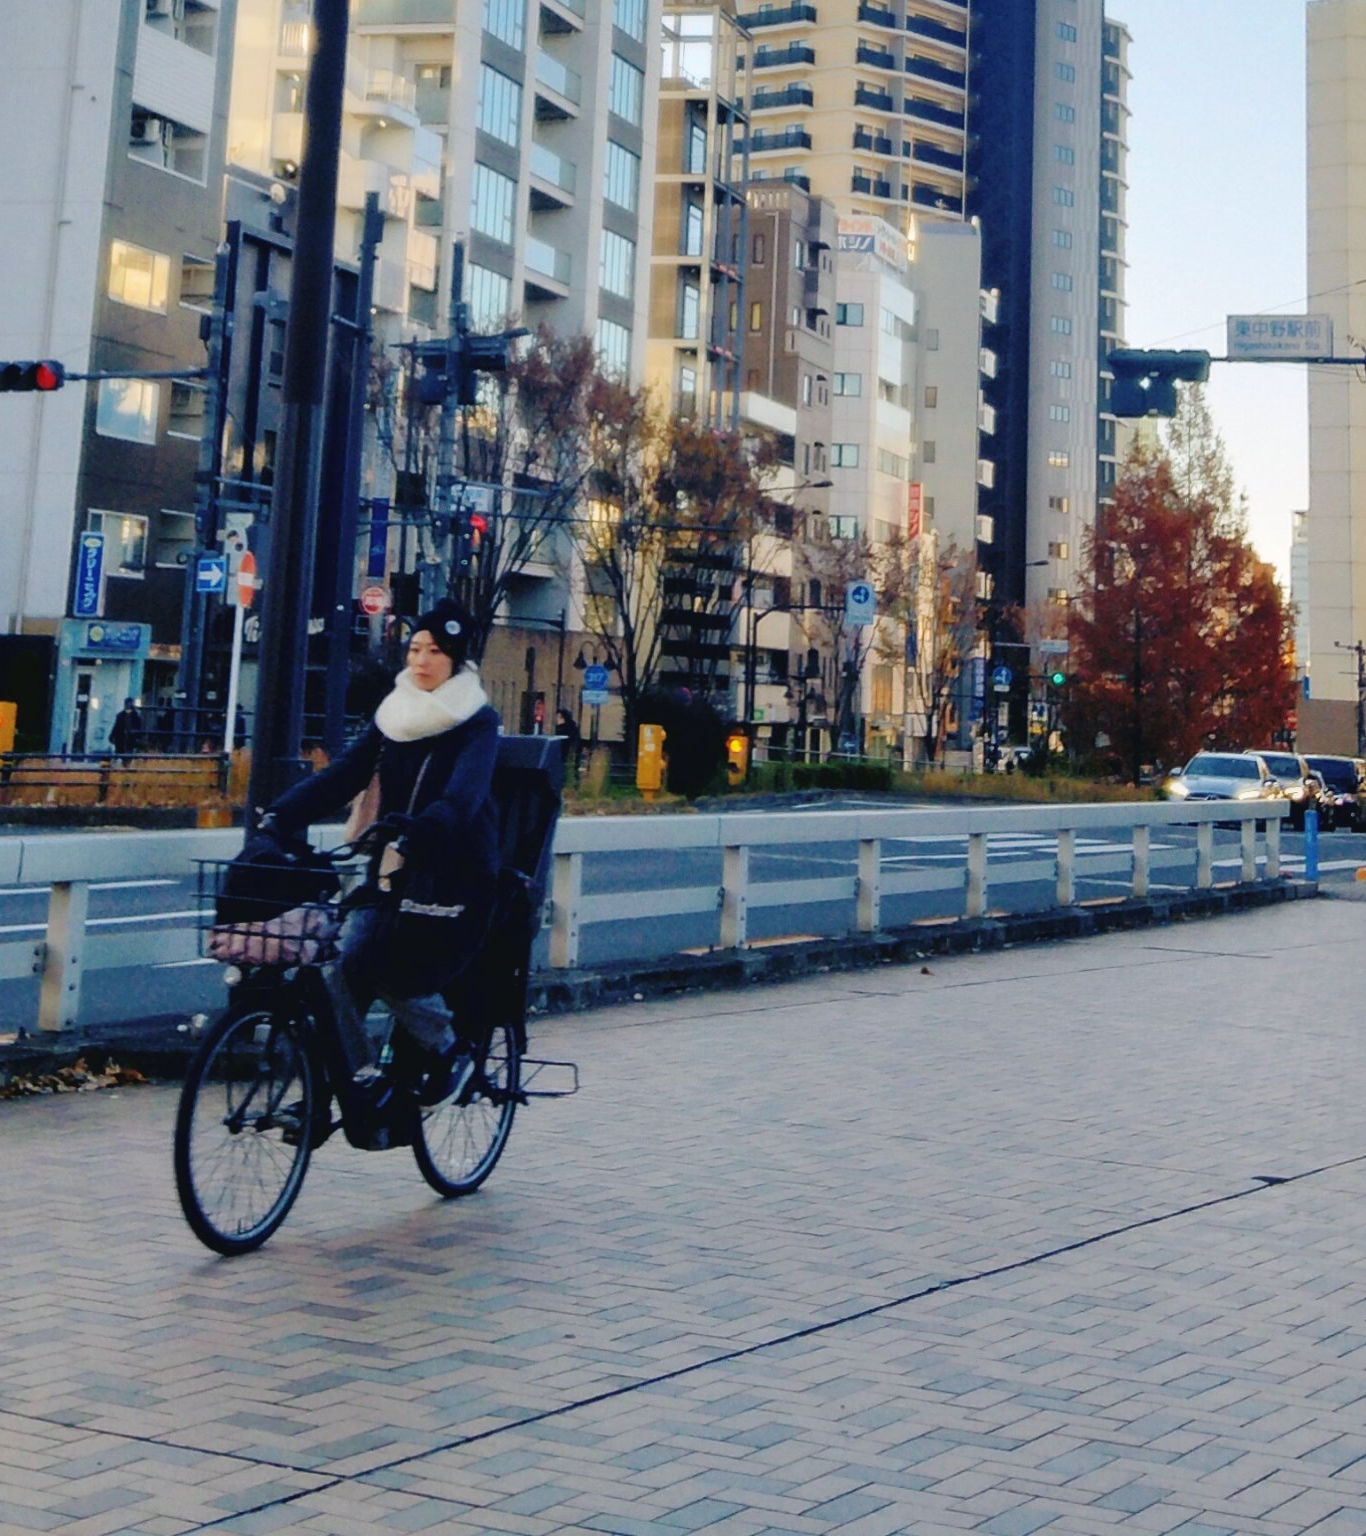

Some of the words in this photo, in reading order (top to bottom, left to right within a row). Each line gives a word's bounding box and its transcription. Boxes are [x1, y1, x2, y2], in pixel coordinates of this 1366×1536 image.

[1235, 320, 1321, 337] 東中野駅前
